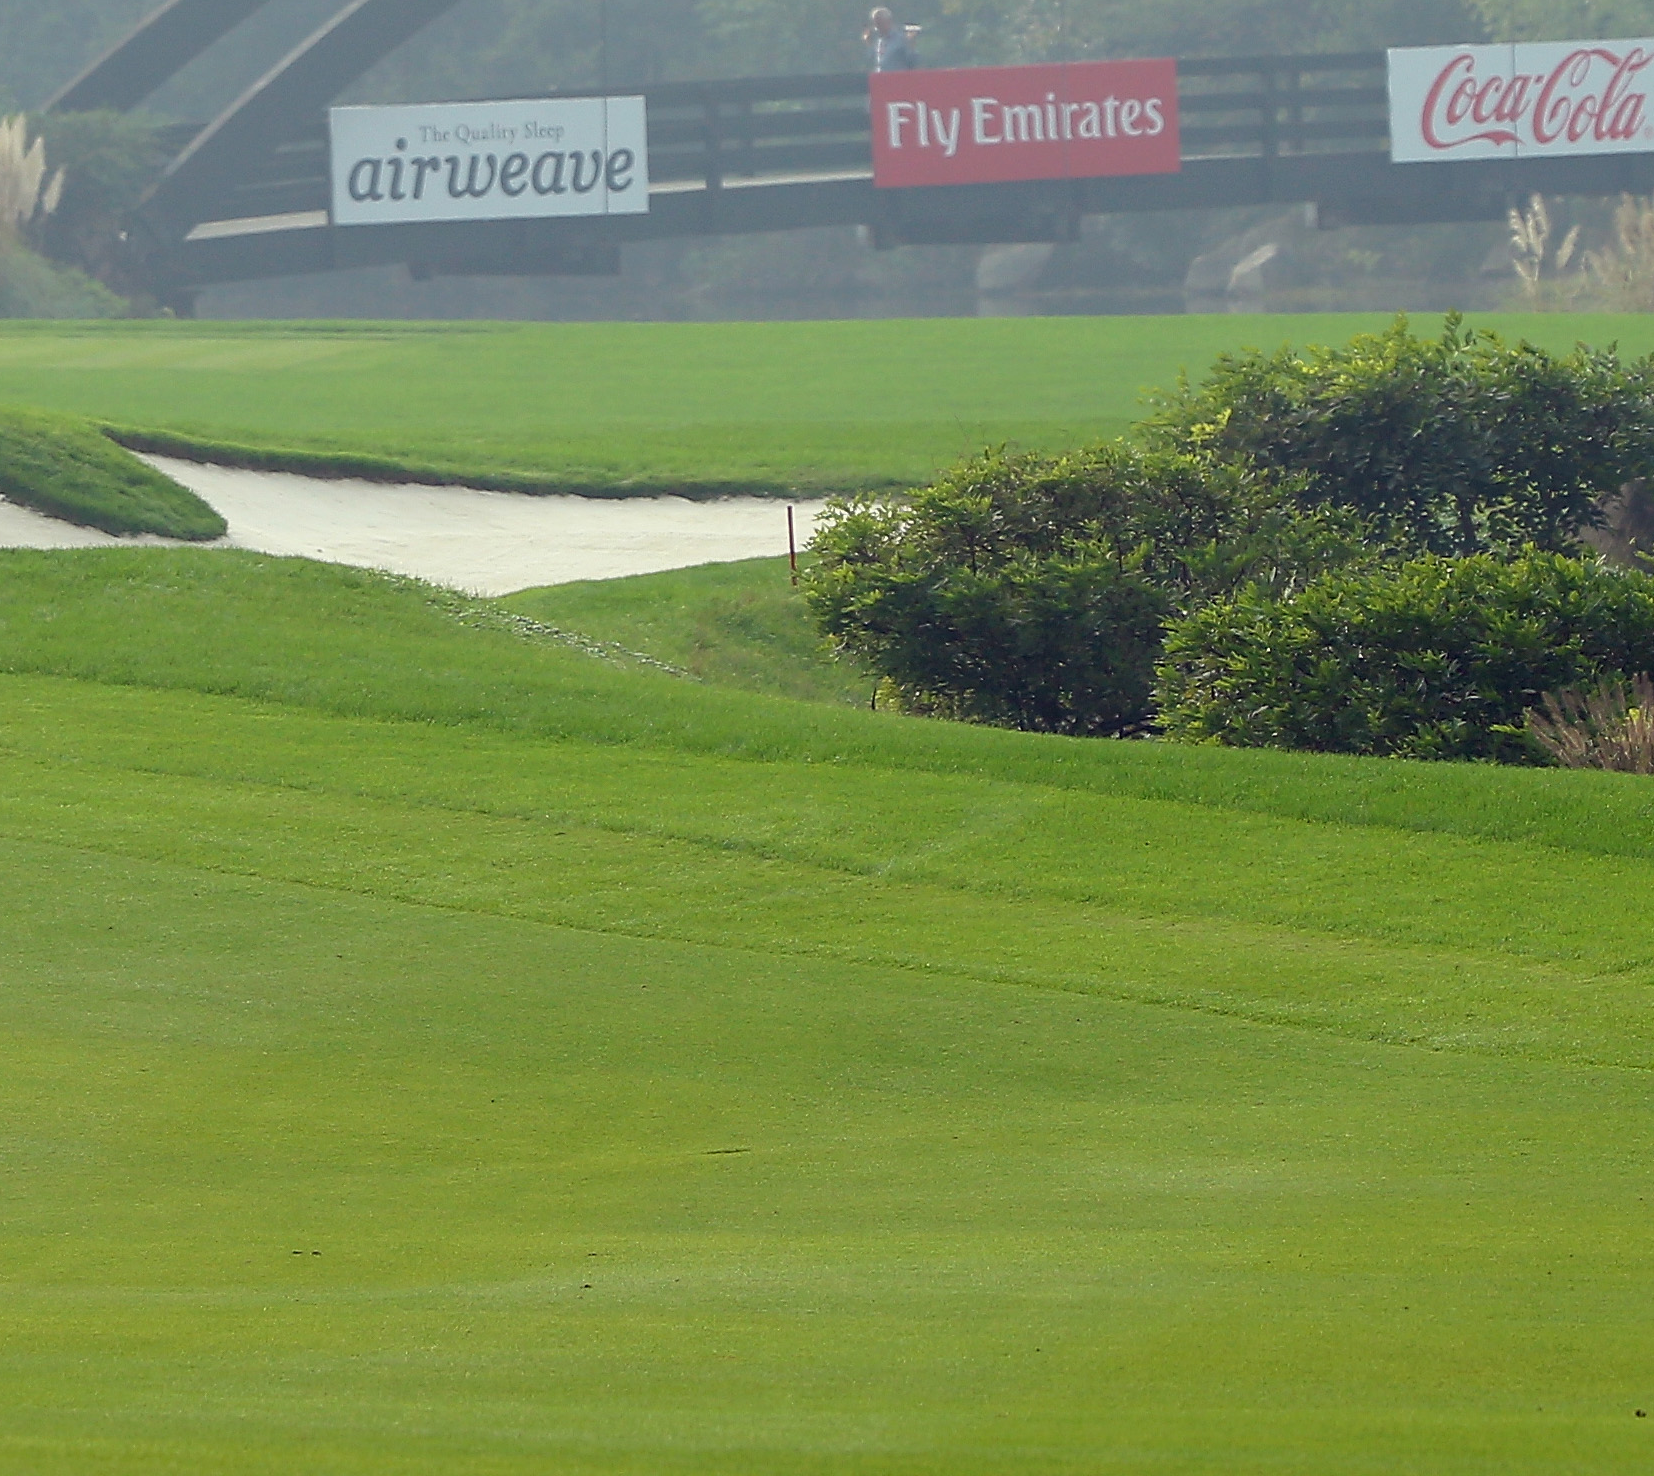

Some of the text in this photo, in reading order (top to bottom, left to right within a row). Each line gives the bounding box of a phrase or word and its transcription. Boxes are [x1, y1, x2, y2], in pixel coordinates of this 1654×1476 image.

[418, 120, 565, 145] The Quality Sleep
[886, 92, 1166, 157] Fly Emirates
[348, 136, 635, 202] airweave
